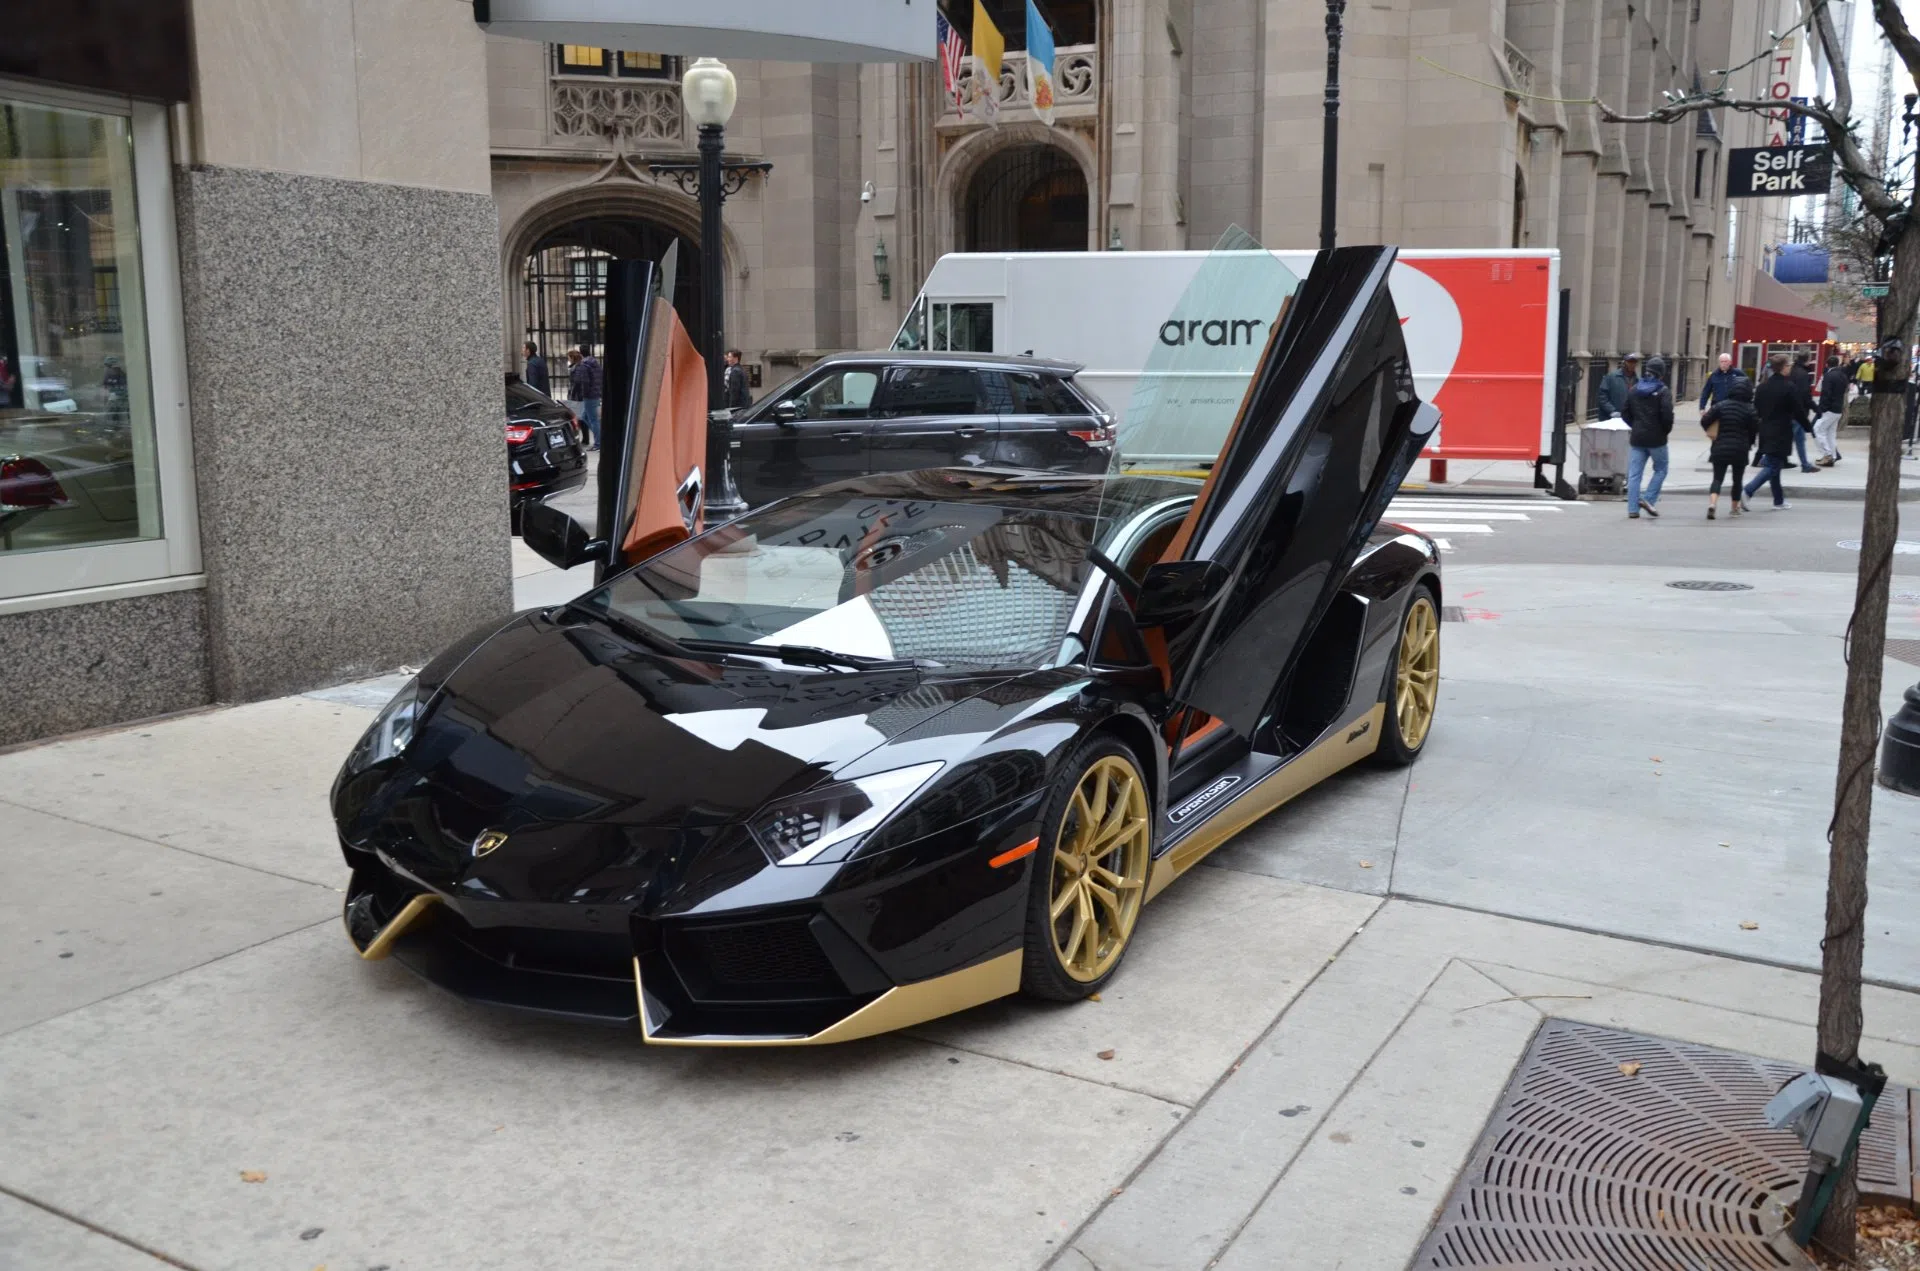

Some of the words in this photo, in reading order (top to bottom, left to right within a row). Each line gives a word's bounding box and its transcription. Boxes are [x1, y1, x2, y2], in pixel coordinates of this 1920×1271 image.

[1753, 150, 1804, 171] Self
[1751, 171, 1806, 191] Park
[1159, 319, 1275, 346] aram
[1178, 780, 1230, 816] AVENTADOR
